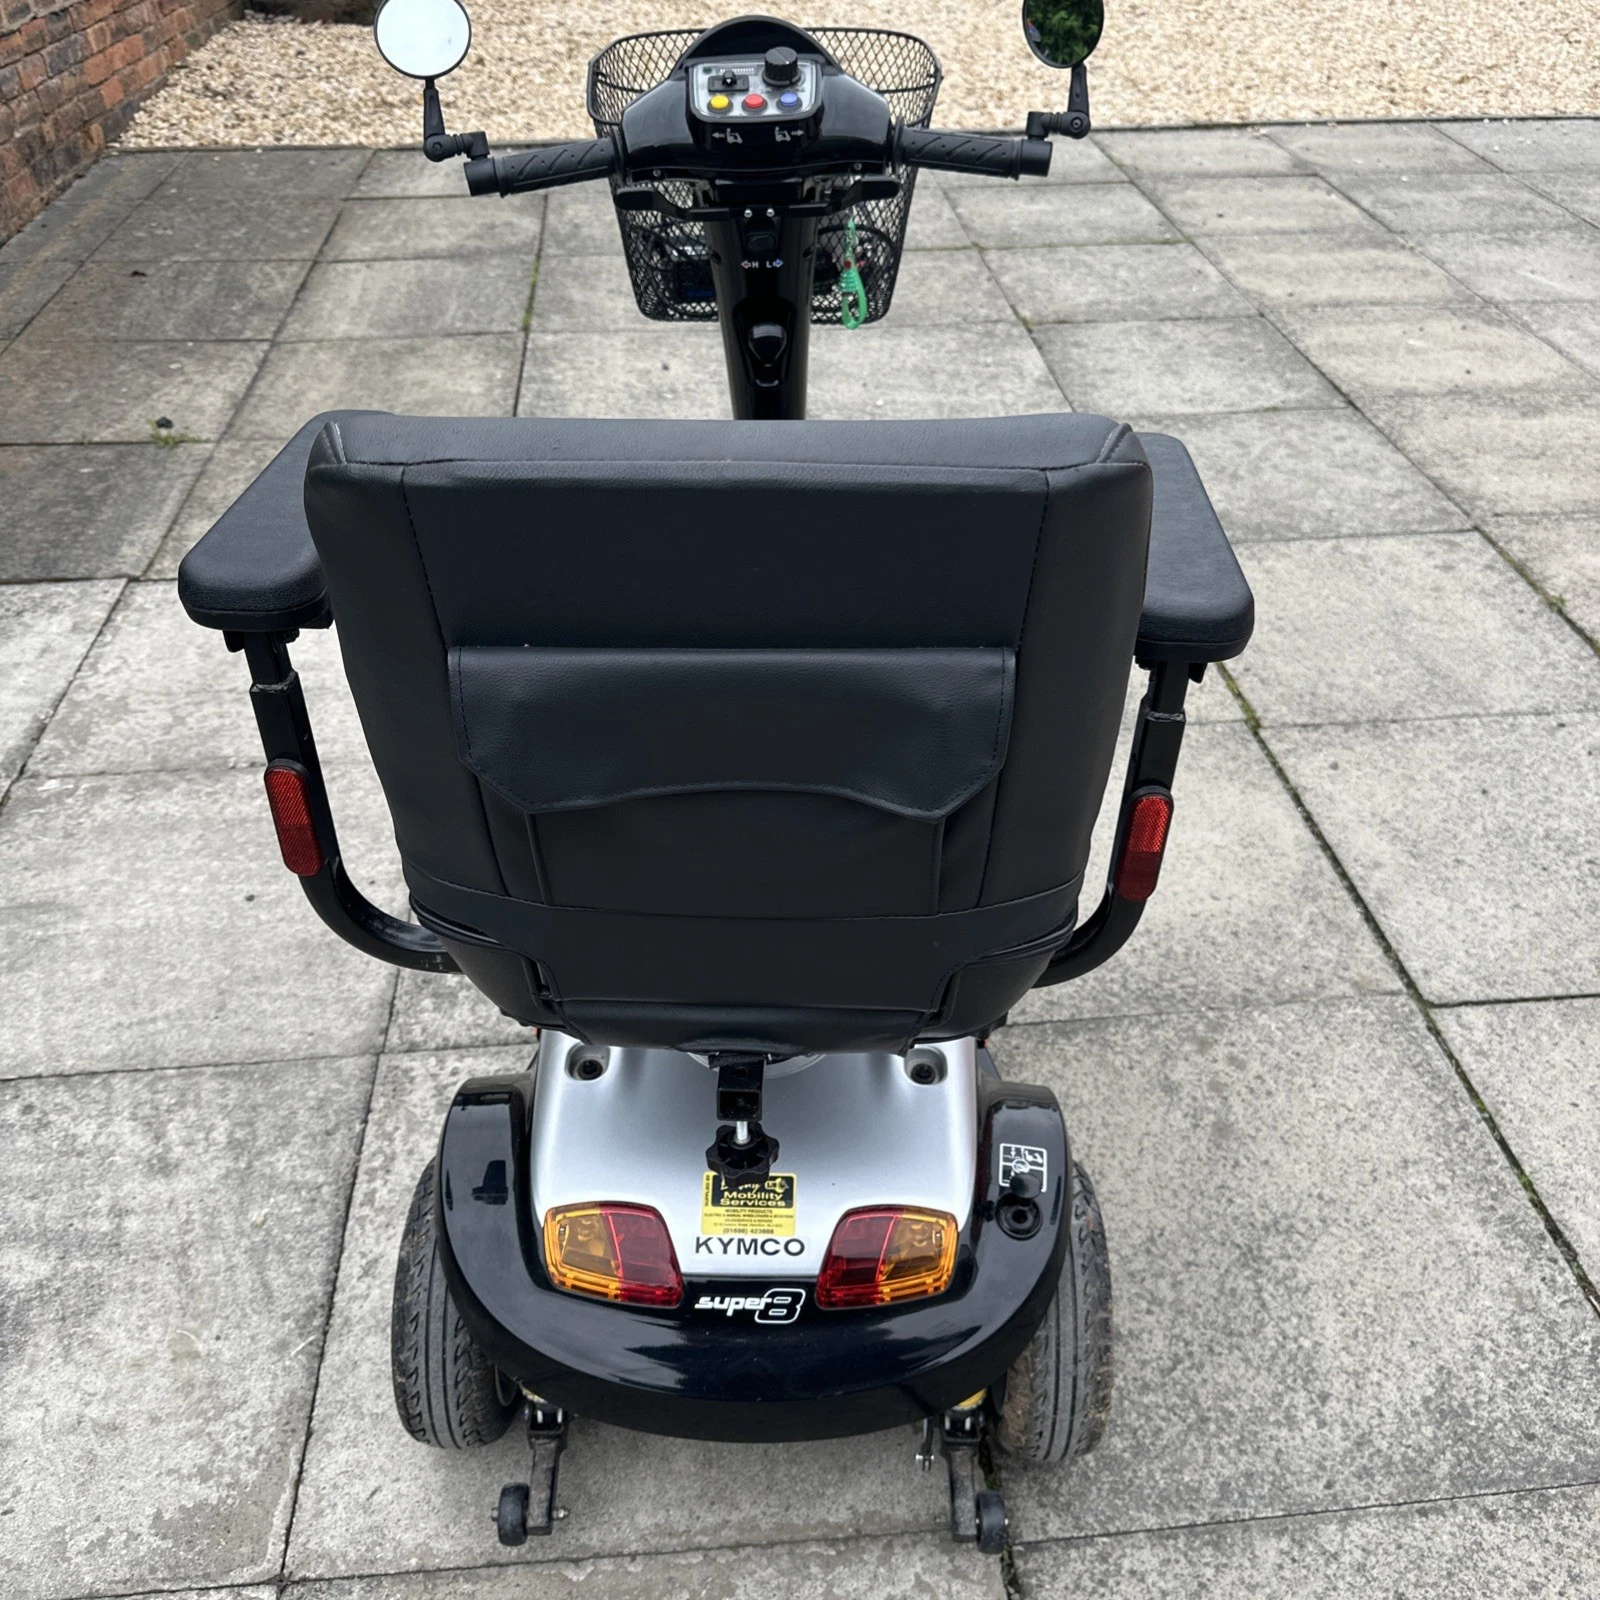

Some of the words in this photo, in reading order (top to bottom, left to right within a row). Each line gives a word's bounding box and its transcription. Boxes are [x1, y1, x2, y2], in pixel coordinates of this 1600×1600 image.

[752, 261, 759, 269] H
[766, 261, 772, 269] L
[723, 1191, 783, 1200] Mobility
[720, 1198, 786, 1207] Services
[695, 1237, 805, 1256] KYMCO
